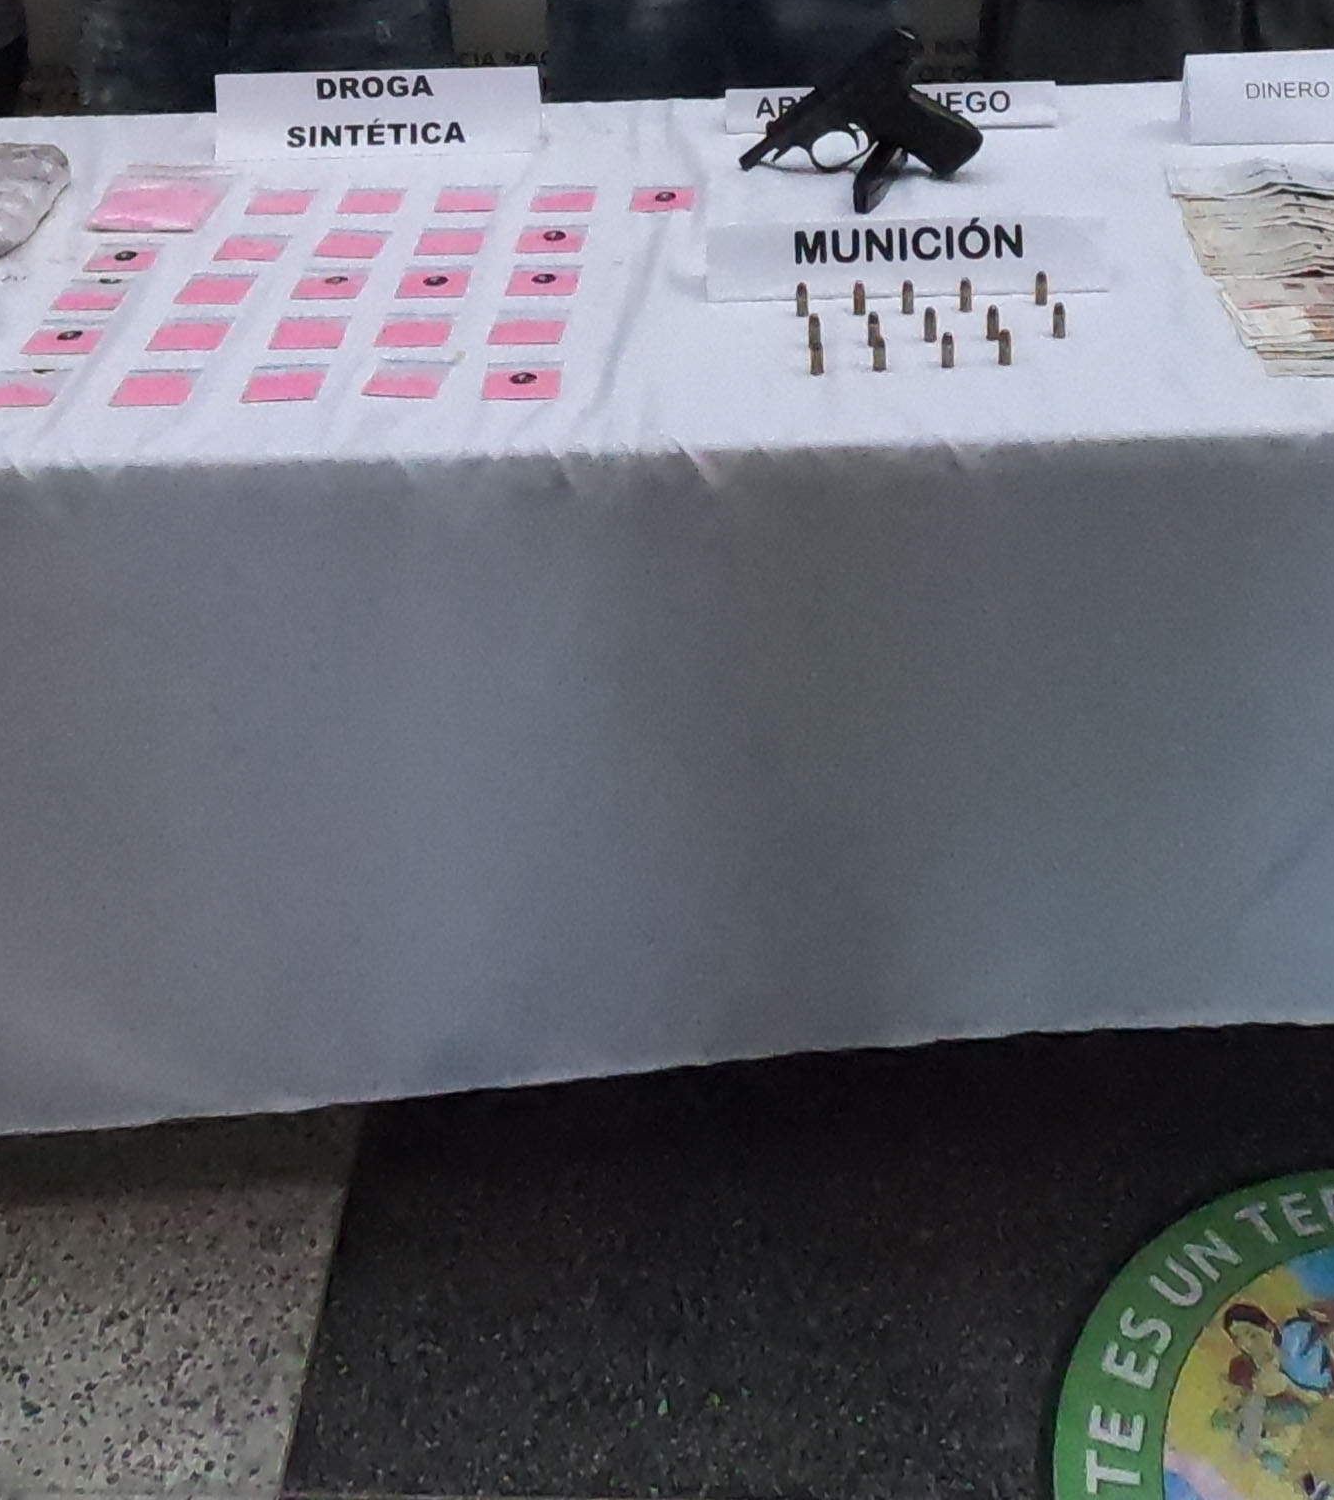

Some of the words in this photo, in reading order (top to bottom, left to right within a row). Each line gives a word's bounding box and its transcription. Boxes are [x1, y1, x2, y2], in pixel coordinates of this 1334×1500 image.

[316, 75, 434, 100] DROGA
[1246, 81, 1330, 99] DINERO
[287, 119, 465, 147] SINTÉTICA
[794, 217, 1023, 264] MUNICIÓN
[1102, 1307, 1172, 1390] ES
[1149, 1228, 1243, 1307] UN
